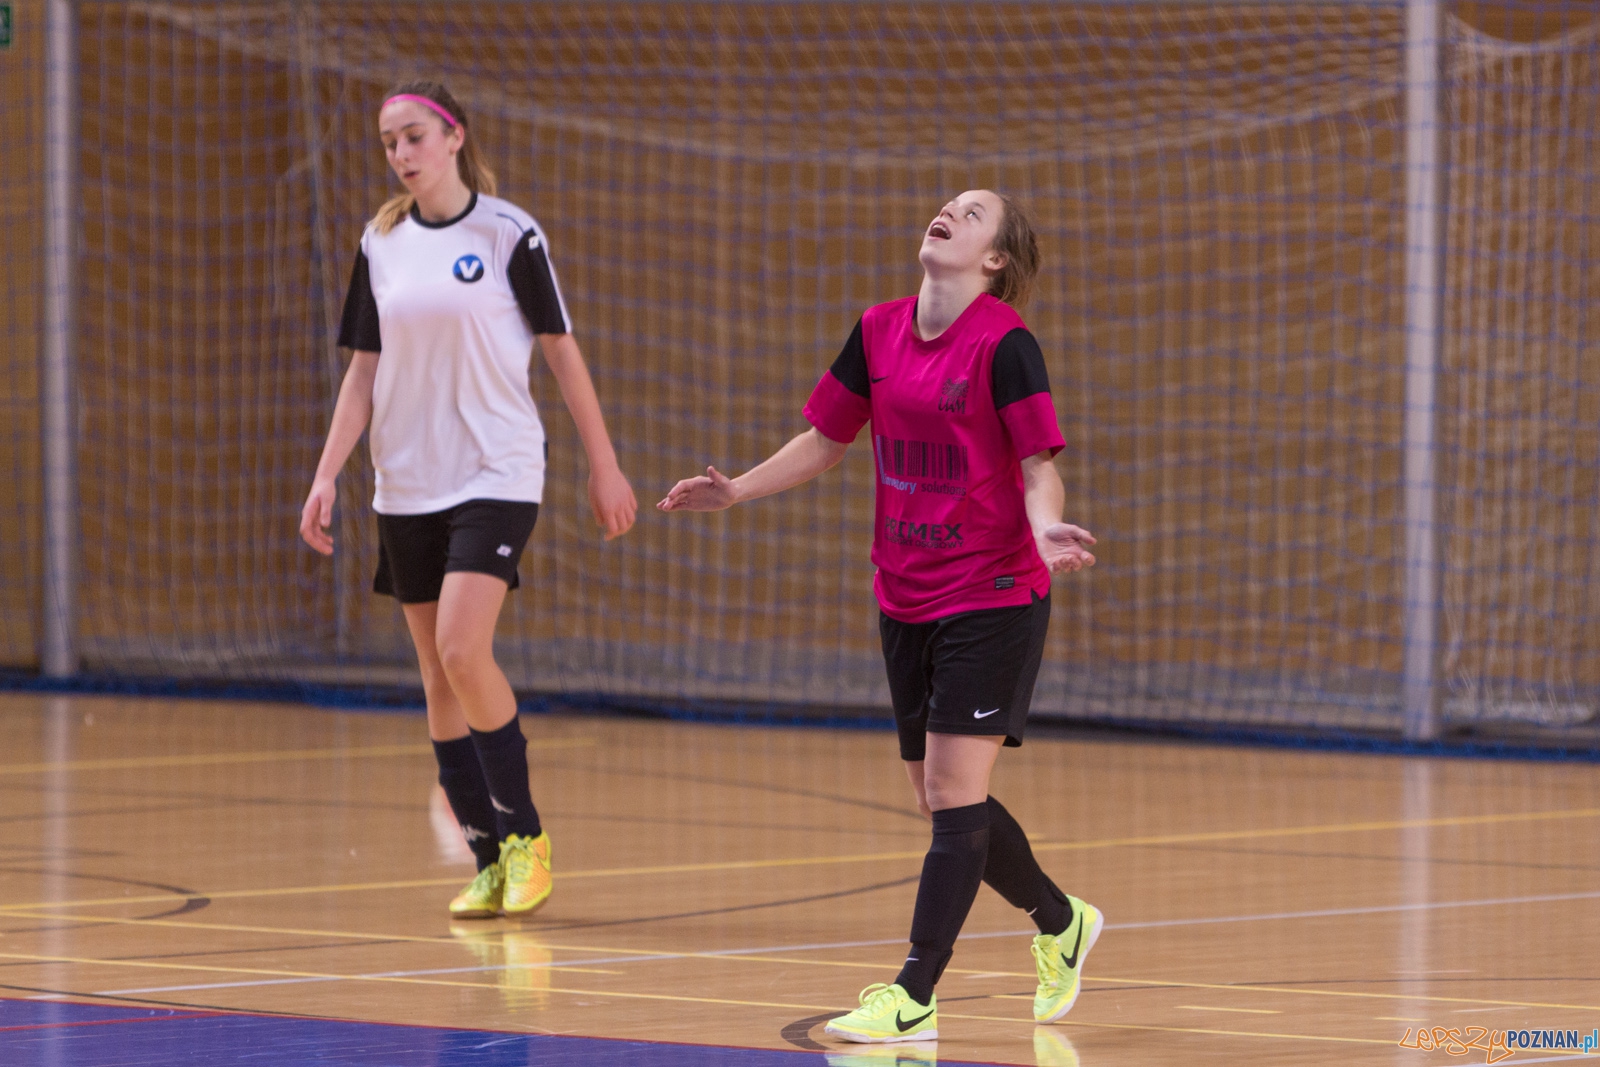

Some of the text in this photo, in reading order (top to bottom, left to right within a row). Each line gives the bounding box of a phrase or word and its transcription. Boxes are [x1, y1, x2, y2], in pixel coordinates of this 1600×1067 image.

[458, 260, 480, 280] V
[921, 481, 967, 497] solutions
[884, 516, 964, 541] PRIMEX
